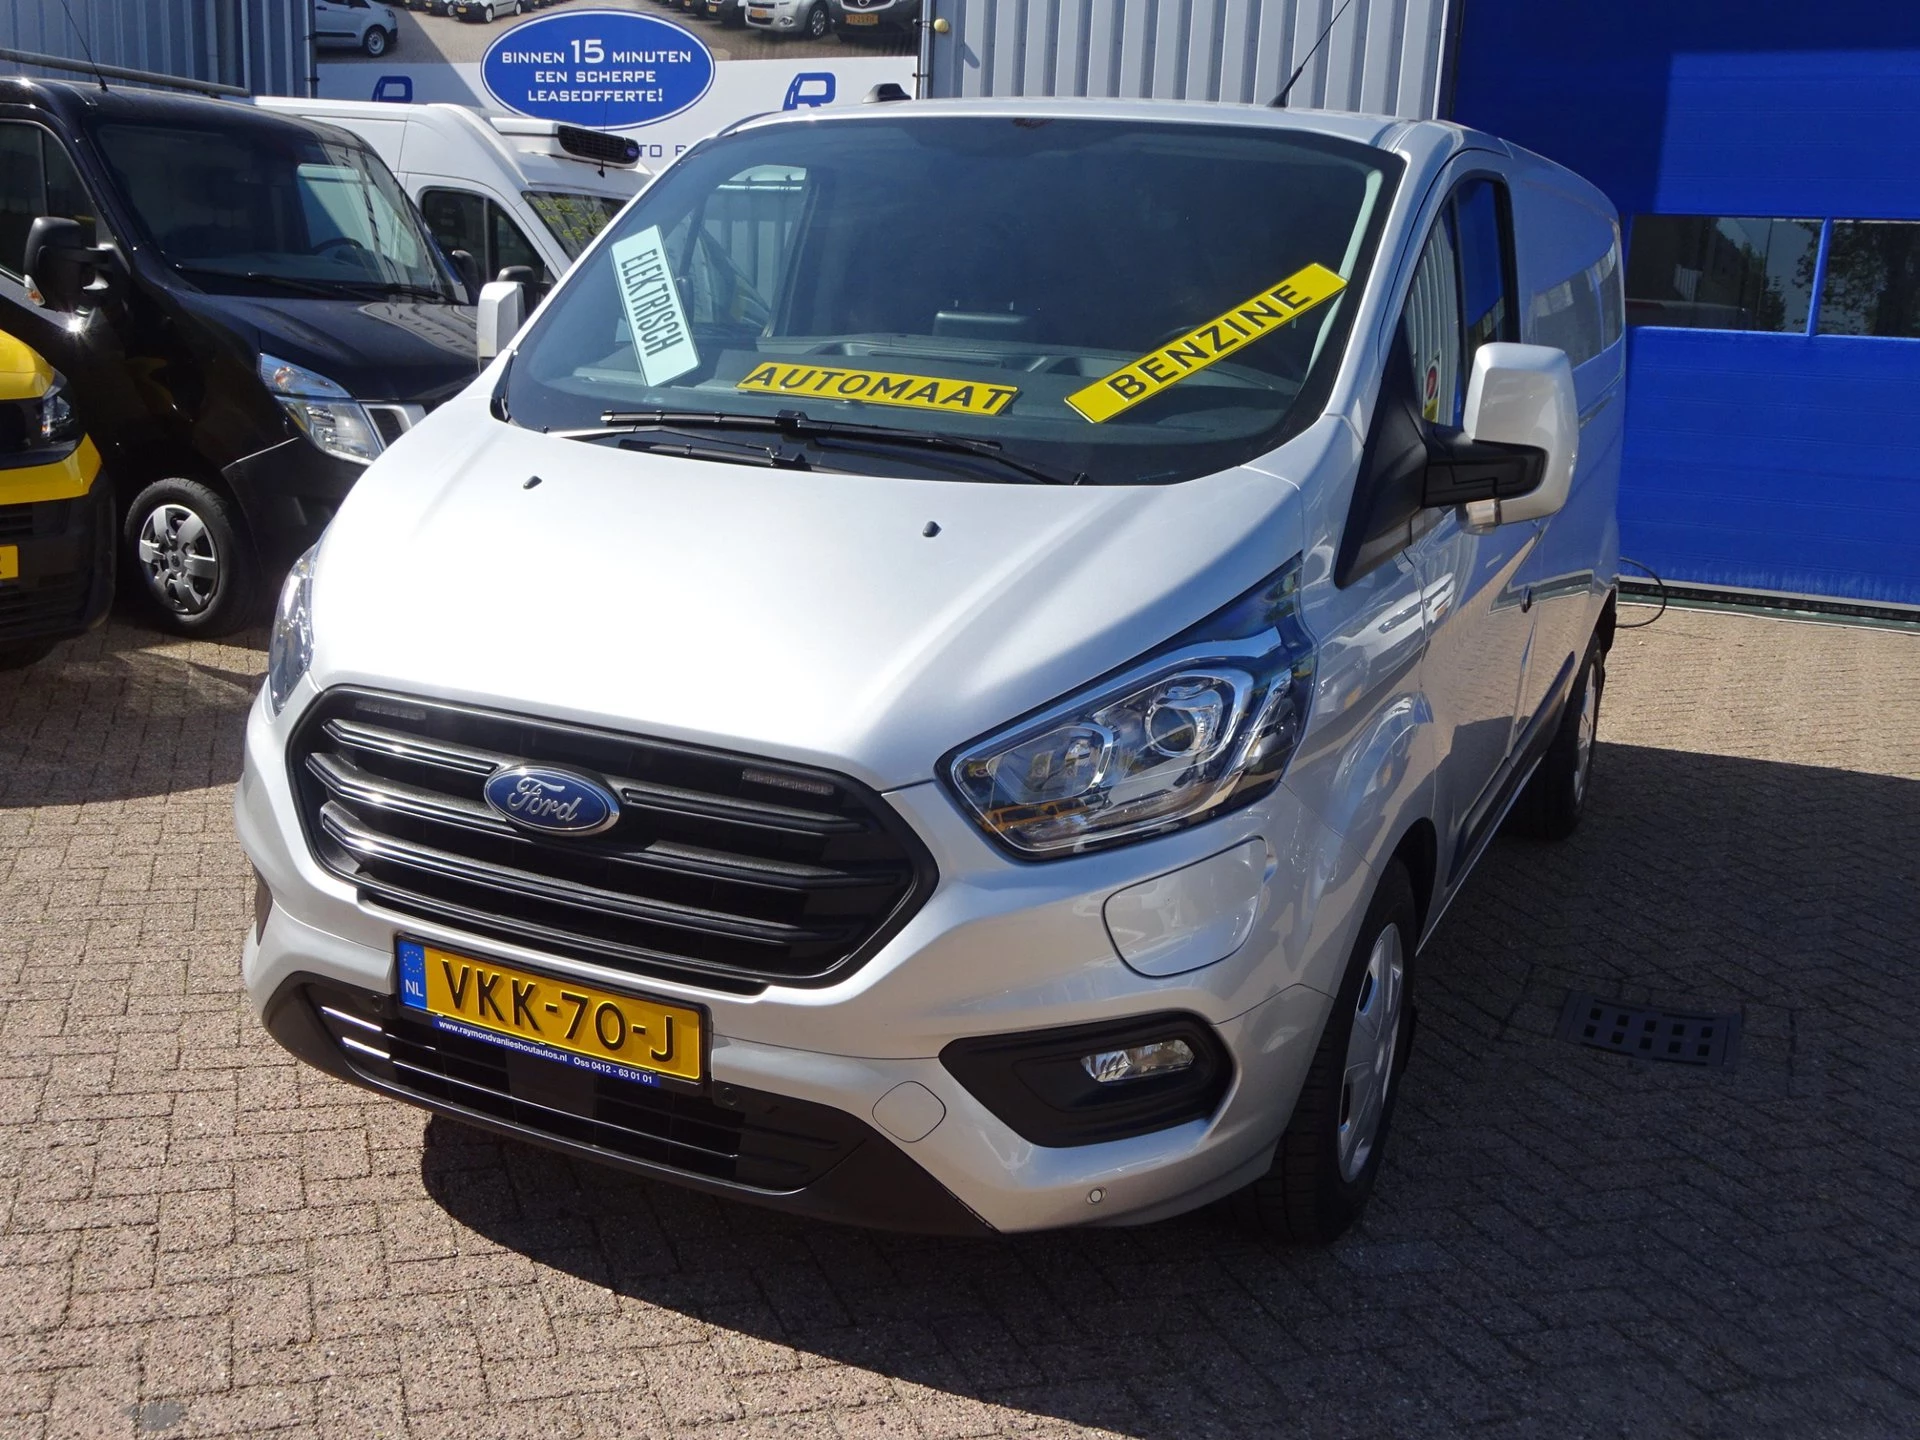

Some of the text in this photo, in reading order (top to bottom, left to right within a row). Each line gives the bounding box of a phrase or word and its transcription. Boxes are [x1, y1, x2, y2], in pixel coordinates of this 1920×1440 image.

[502, 39, 692, 64] BINNEN 15 MINUTEN
[528, 88, 663, 102] LEASEOFFERTE!
[535, 71, 656, 83] EEN SCHERPE
[638, 144, 663, 158] TO
[621, 248, 684, 357] ELEKTRISCH
[1106, 284, 1313, 402] BENZINE
[744, 366, 1013, 410] AUTOMAAT
[507, 777, 582, 822] Ford
[405, 978, 424, 997] NL
[441, 959, 674, 1062] VKK-70-J
[438, 1020, 568, 1062] www.raymondvanlieshoutautos.nl
[573, 1056, 590, 1069] Oss
[591, 1061, 612, 1074] 0412
[618, 1068, 629, 1078] 63
[630, 1071, 641, 1081] 01
[642, 1074, 653, 1084] 01
